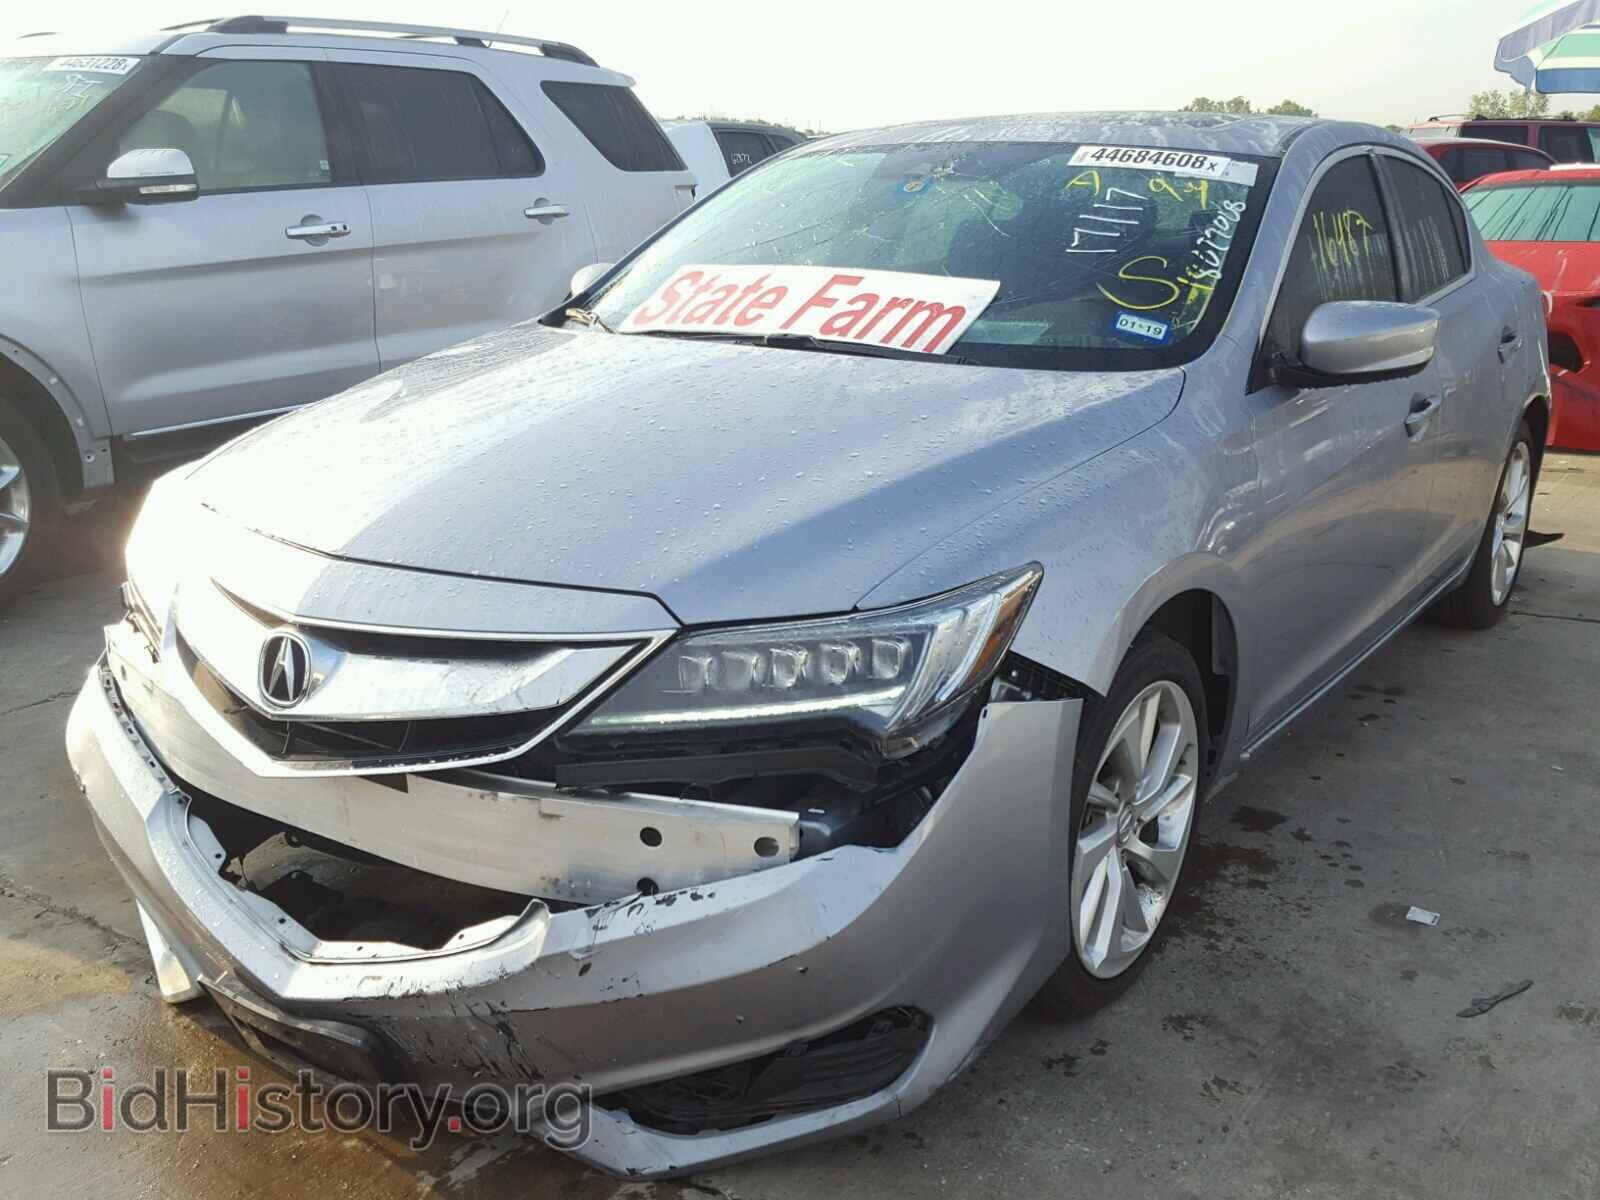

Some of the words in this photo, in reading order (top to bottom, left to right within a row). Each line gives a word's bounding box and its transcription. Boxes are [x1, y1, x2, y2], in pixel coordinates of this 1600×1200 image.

[633, 270, 789, 326] State
[779, 274, 967, 353] Farm
[1095, 255, 1180, 310] S
